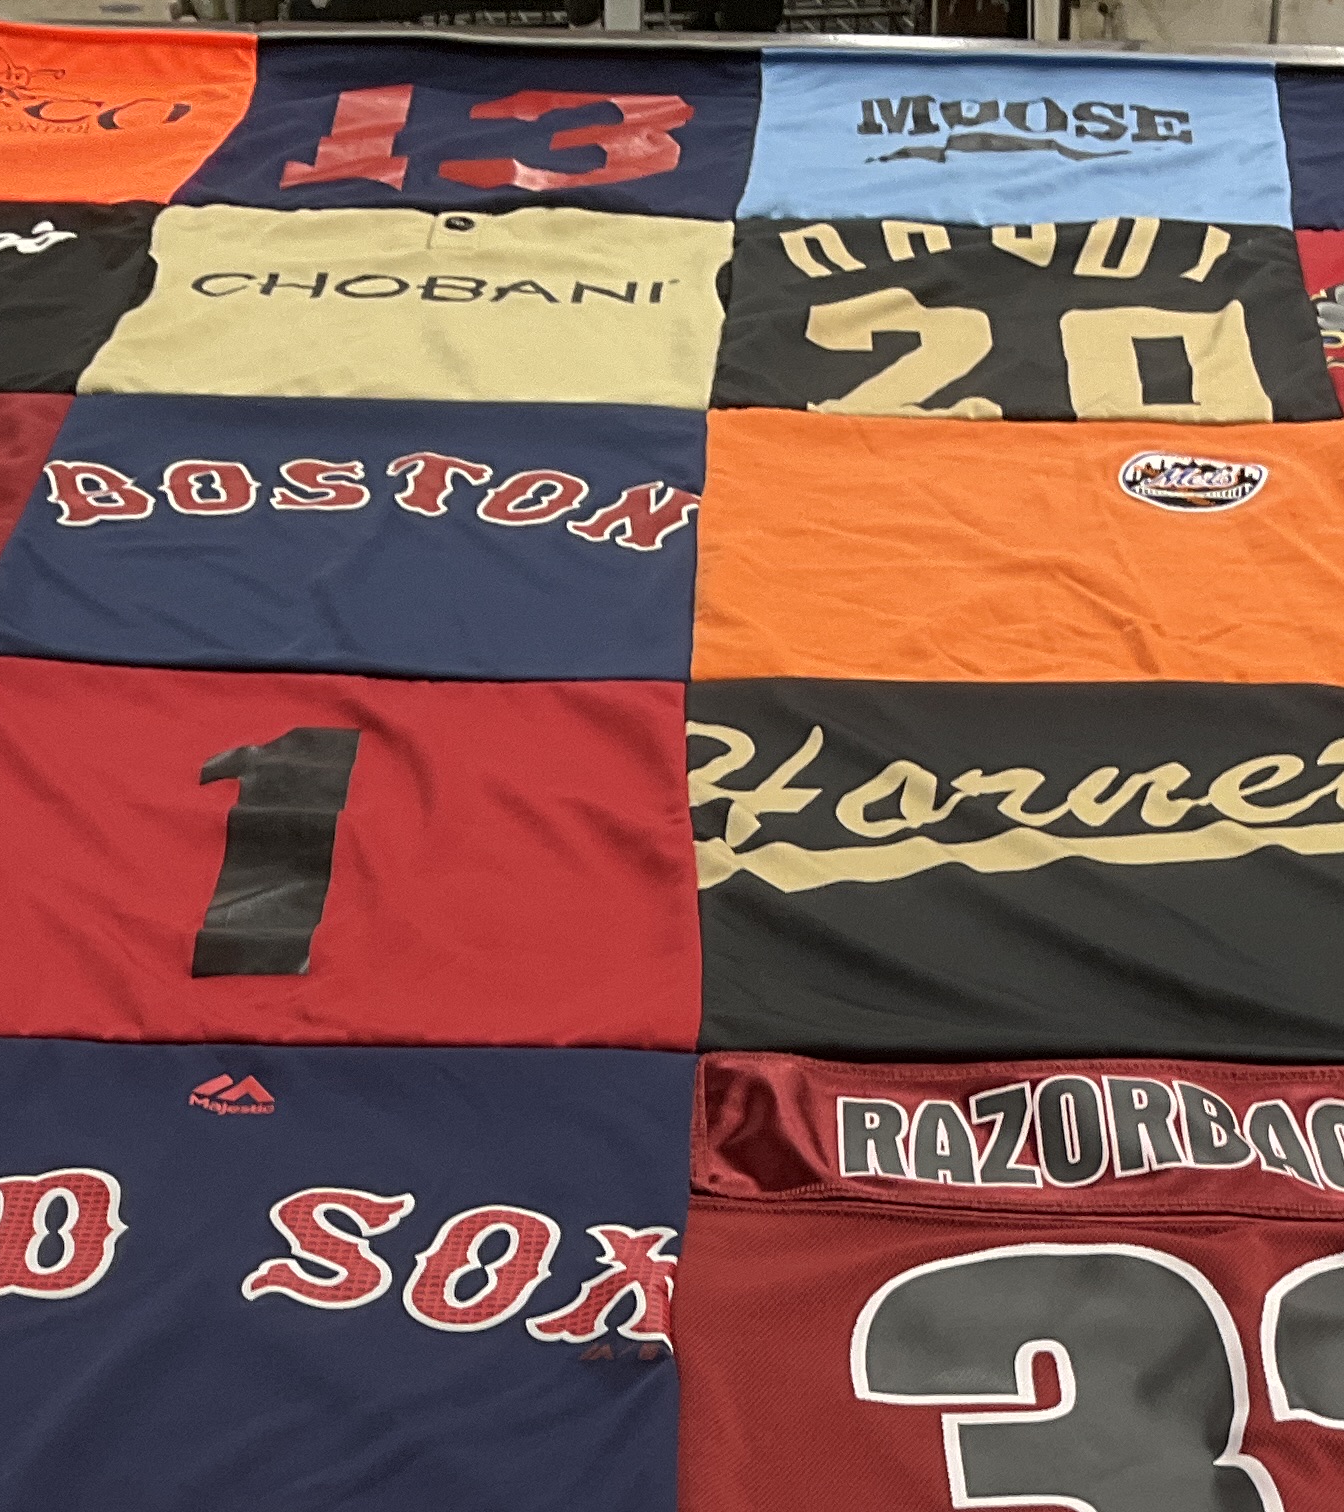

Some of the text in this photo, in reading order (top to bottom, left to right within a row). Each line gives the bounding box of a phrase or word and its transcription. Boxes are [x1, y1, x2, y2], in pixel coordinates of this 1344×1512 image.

[279, 84, 695, 192] 13
[856, 95, 1194, 145] MOOSE
[191, 271, 675, 305] CHOBANI
[804, 288, 1274, 424] 20
[43, 451, 702, 551] BOSTON
[191, 726, 362, 979] 1
[241, 1187, 676, 1354] SOX
